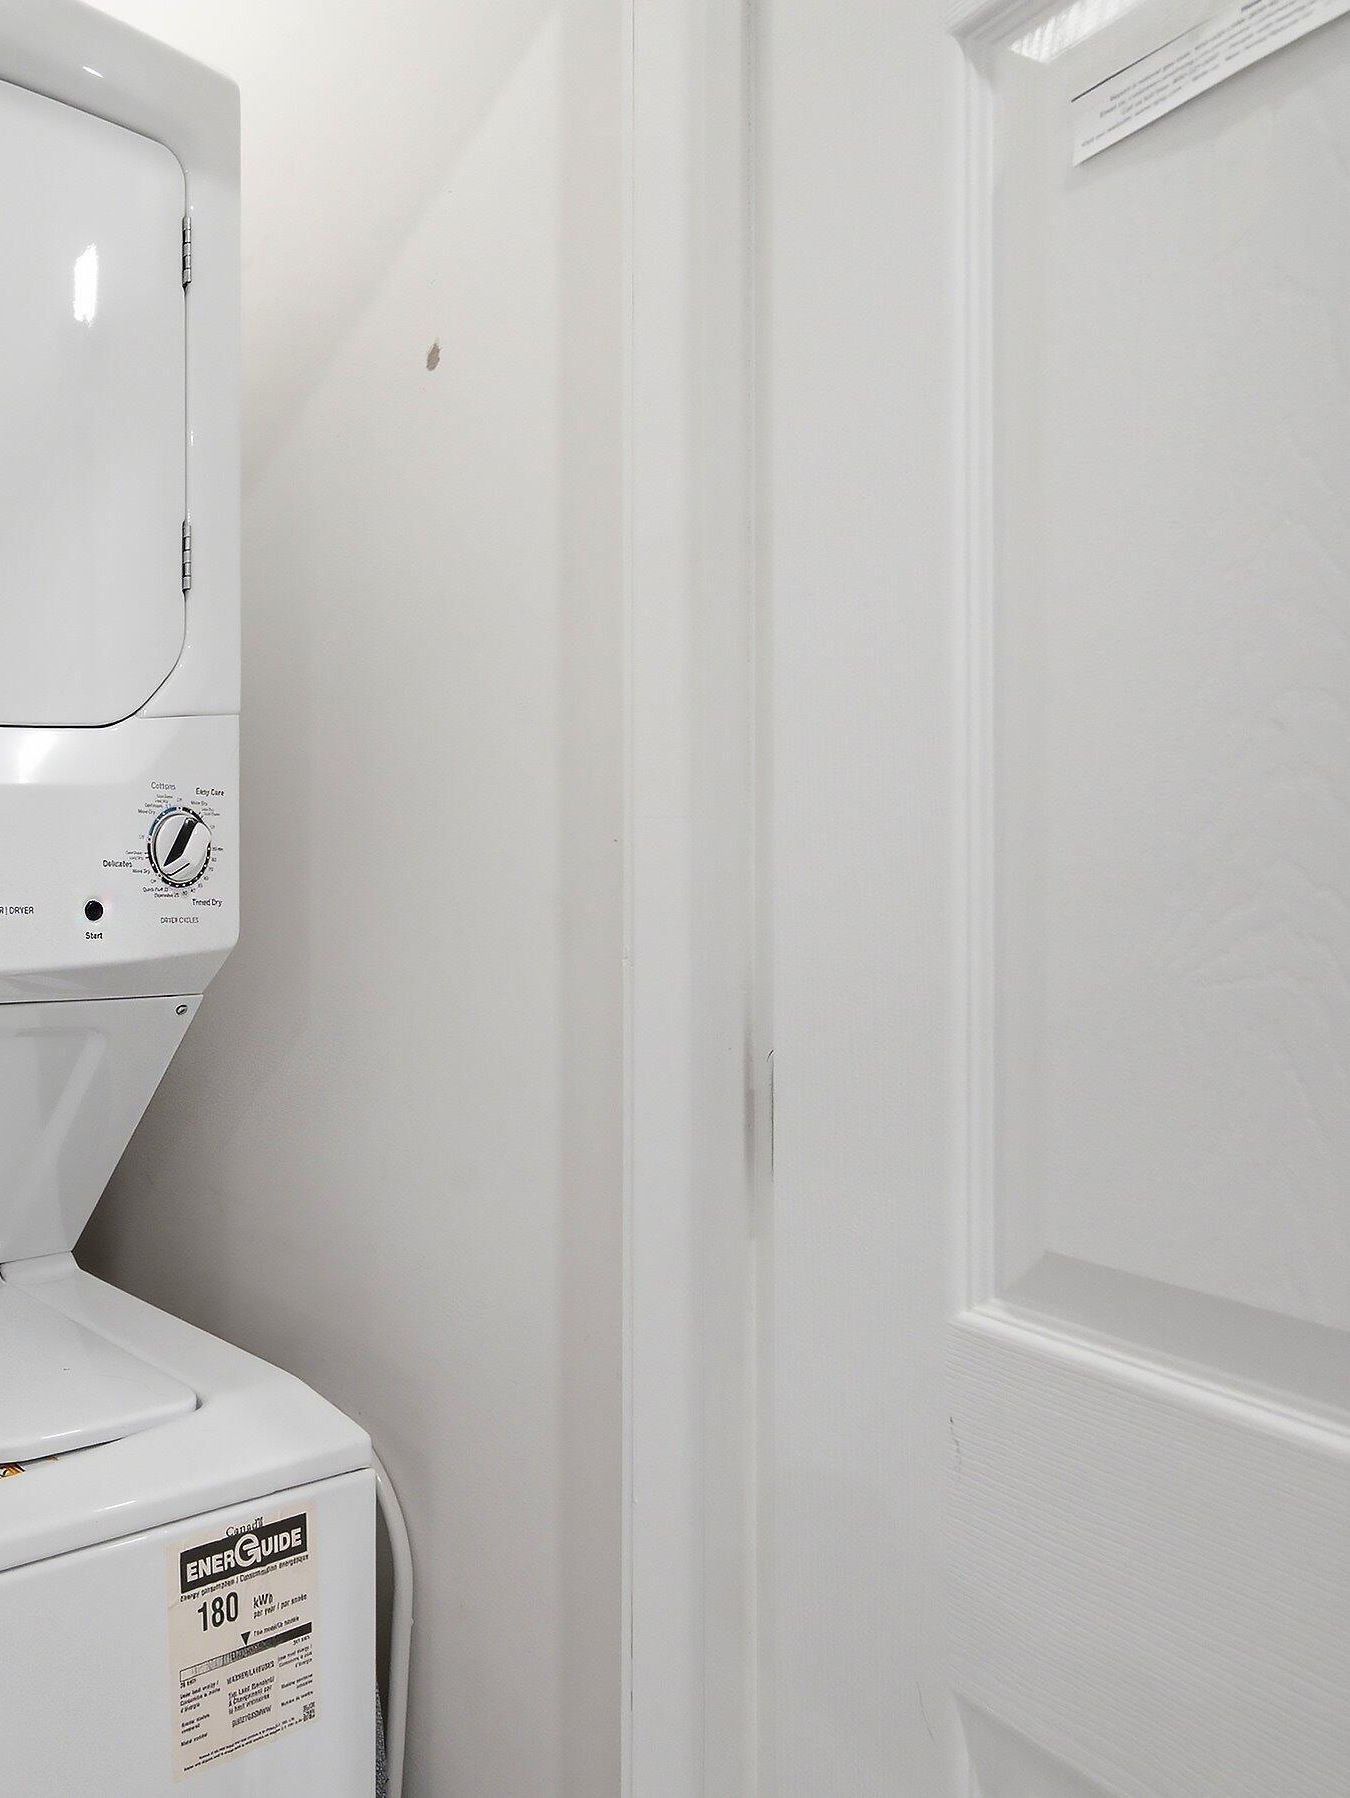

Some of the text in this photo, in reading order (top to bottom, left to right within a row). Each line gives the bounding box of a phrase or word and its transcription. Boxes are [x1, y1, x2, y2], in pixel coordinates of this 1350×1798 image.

[102, 859, 133, 868] Delicates
[211, 899, 223, 908] Dry
[8, 906, 35, 915] DRYER
[85, 931, 103, 940] Start
[197, 1591, 239, 1632] 180
